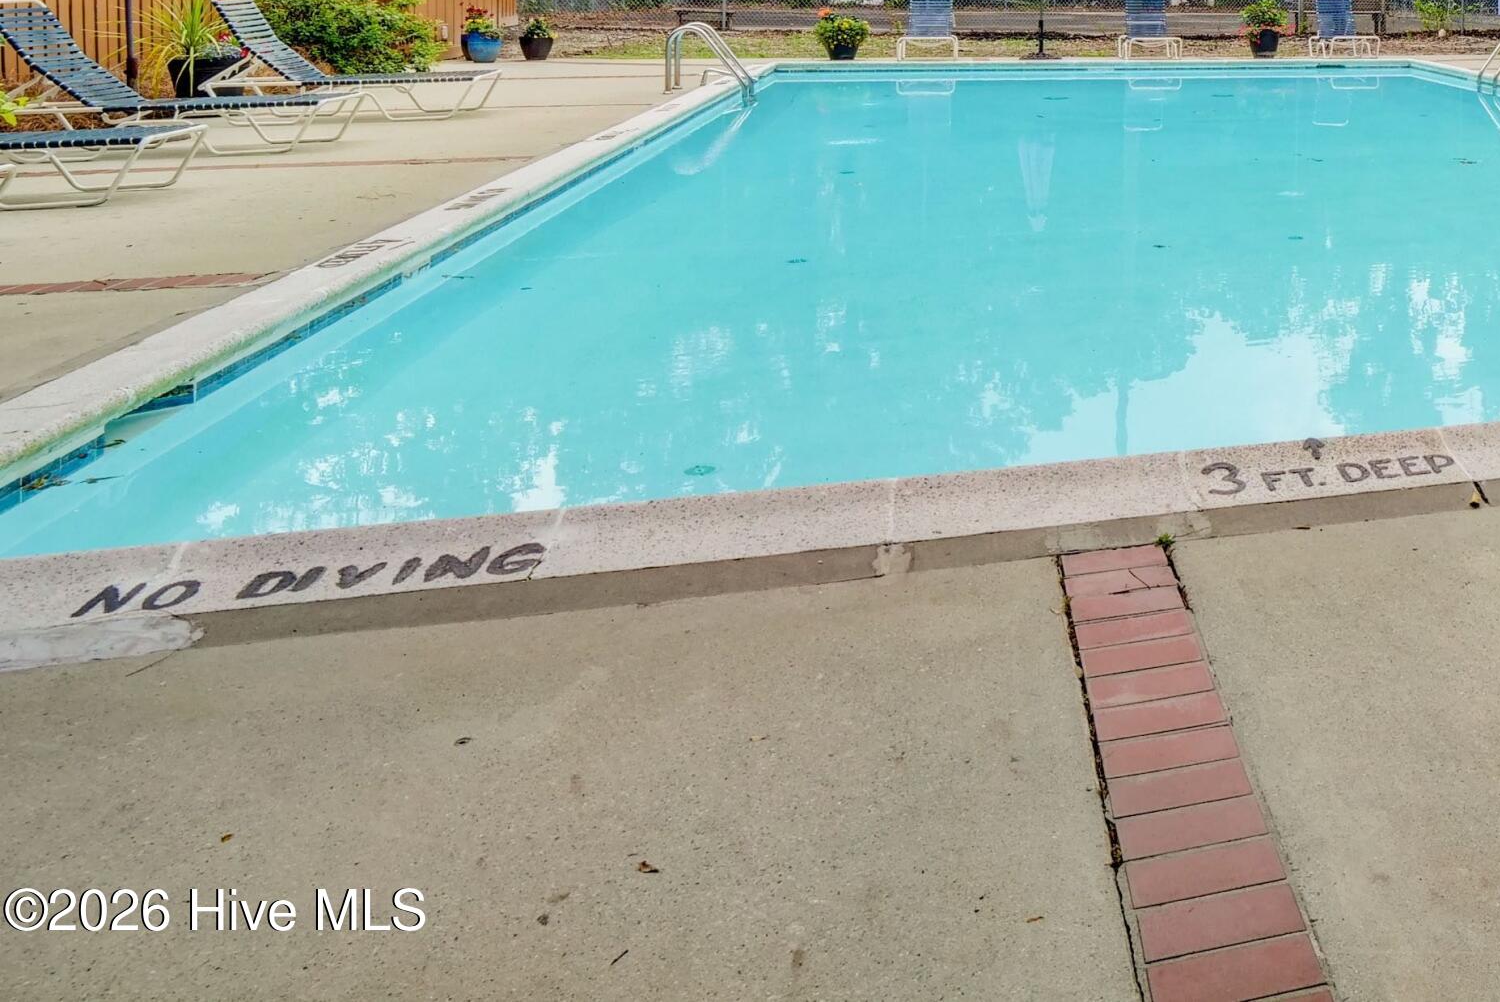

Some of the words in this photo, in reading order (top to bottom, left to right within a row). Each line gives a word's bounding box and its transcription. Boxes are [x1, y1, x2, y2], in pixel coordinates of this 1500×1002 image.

[1201, 462, 1247, 495] 3
[1261, 467, 1327, 492] FT.
[1336, 454, 1455, 483] DEEP
[71, 579, 204, 618] NO
[235, 542, 547, 600] DIVING
